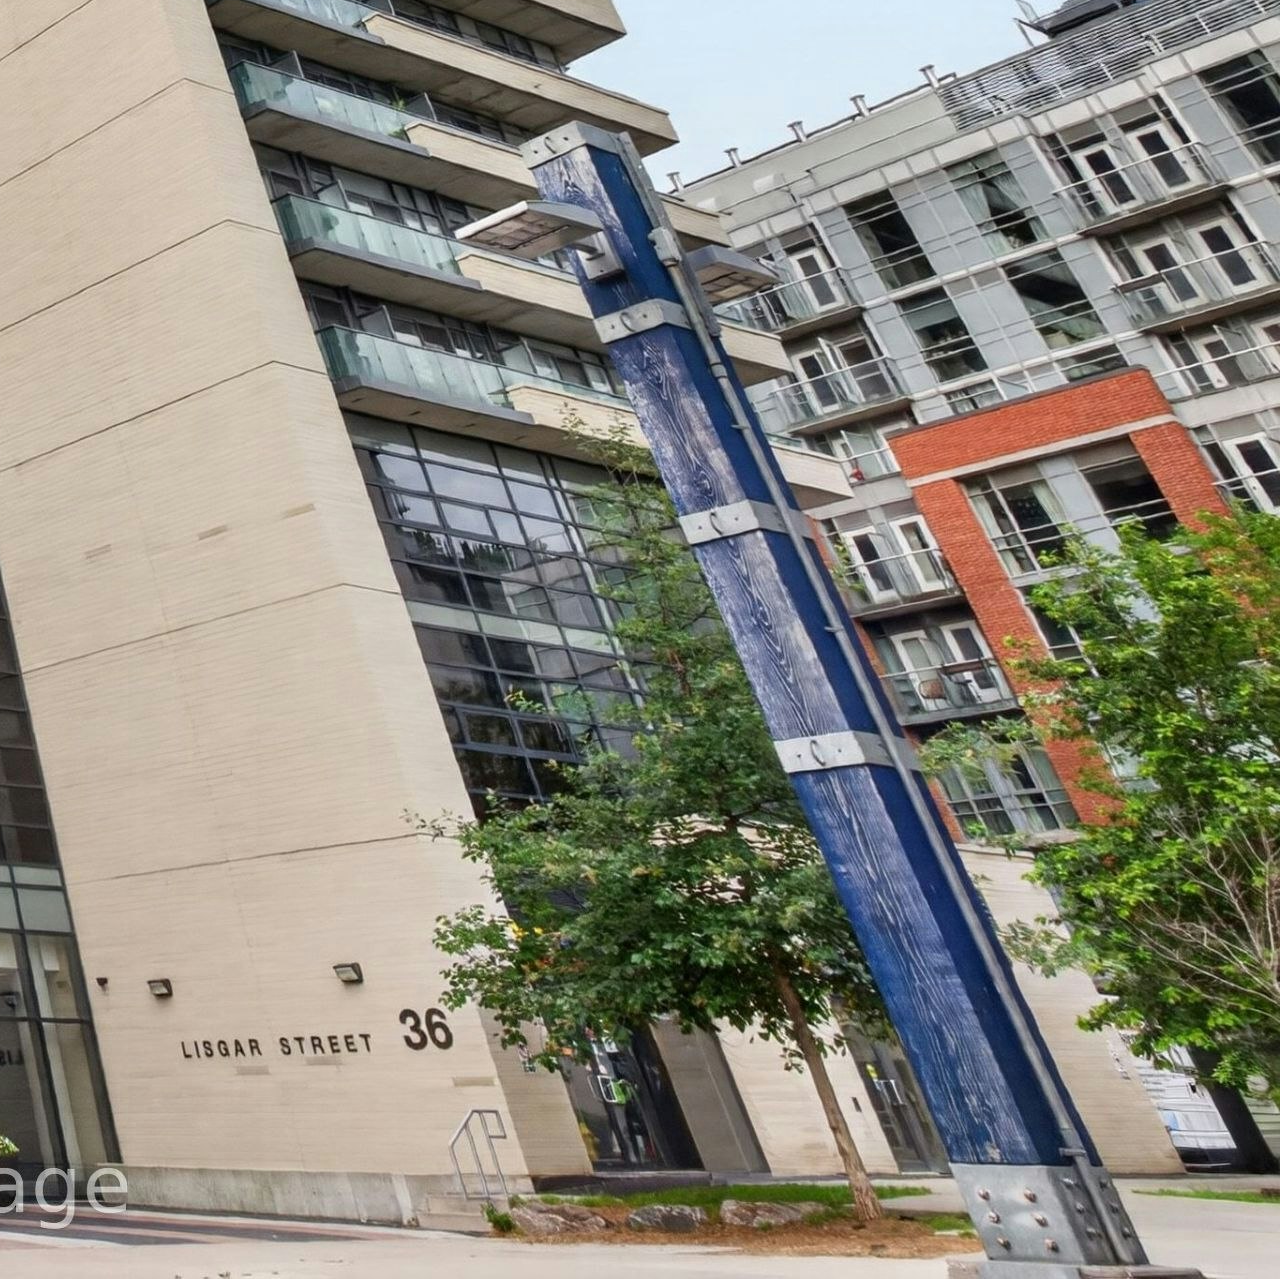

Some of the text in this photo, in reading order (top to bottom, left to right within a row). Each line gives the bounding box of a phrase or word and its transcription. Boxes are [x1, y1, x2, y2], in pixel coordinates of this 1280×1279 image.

[181, 1008, 453, 1058] LISGAR STREET 36
